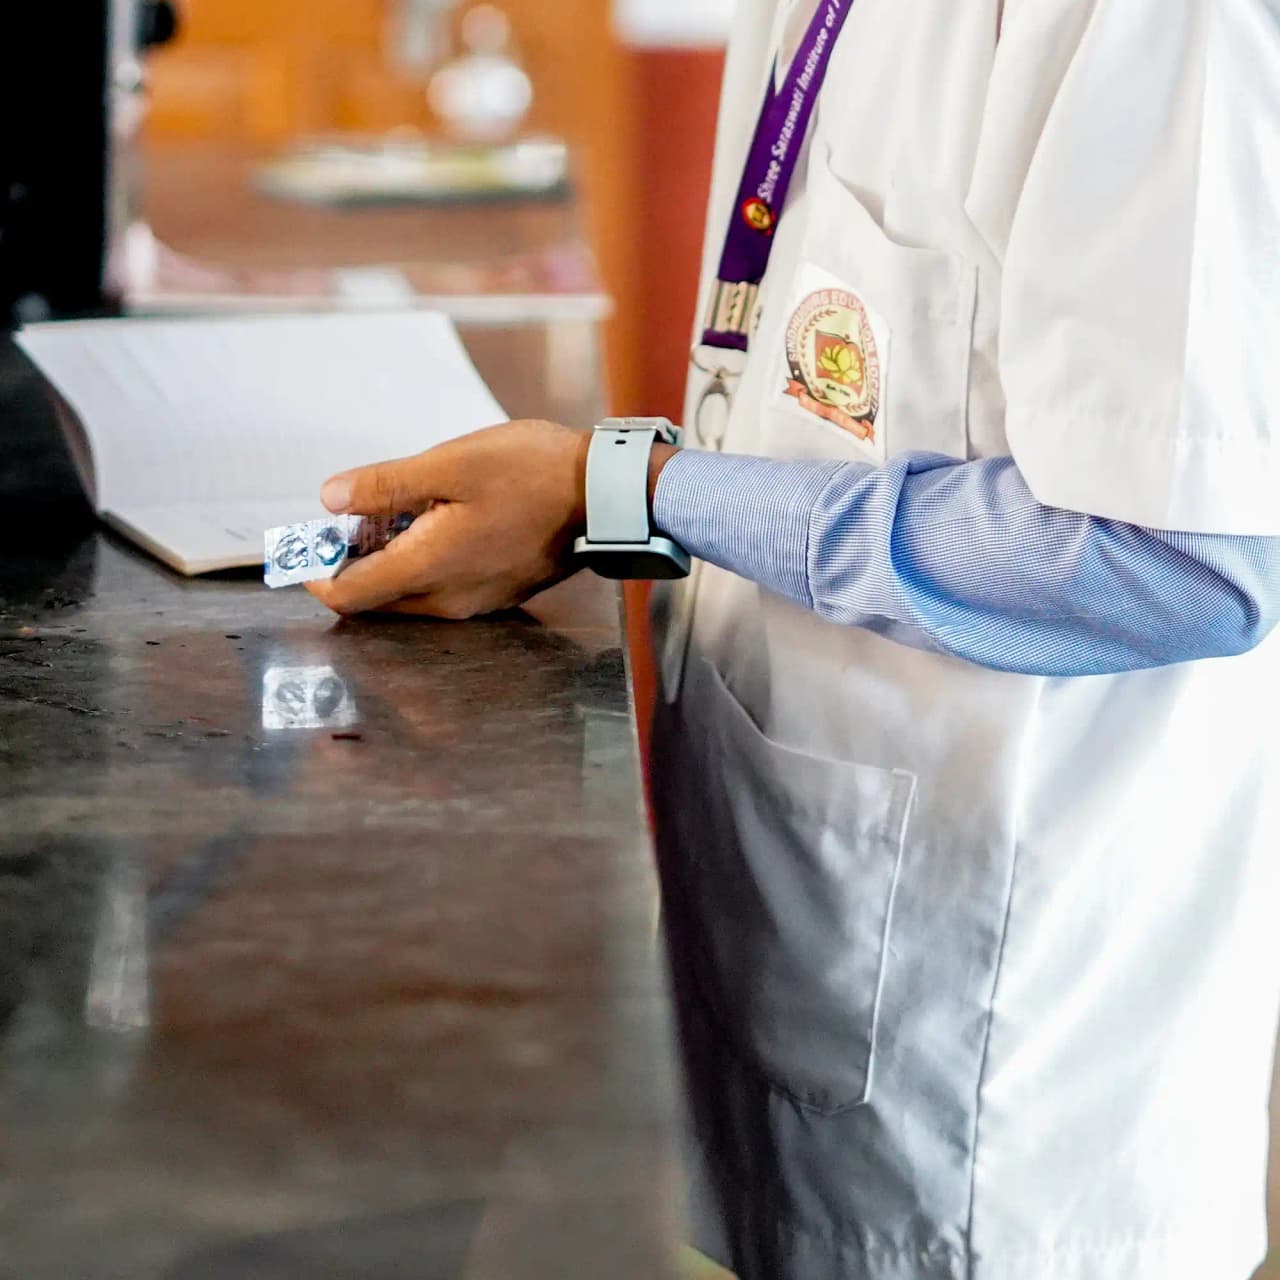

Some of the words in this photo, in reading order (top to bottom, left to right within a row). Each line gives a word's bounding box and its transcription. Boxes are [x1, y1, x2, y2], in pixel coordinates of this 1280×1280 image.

[757, 160, 781, 203] Shree
[771, 87, 804, 161] Saraswati
[796, 28, 828, 91] Institute
[826, 5, 838, 28] of
[831, 290, 875, 351] EDUCON
